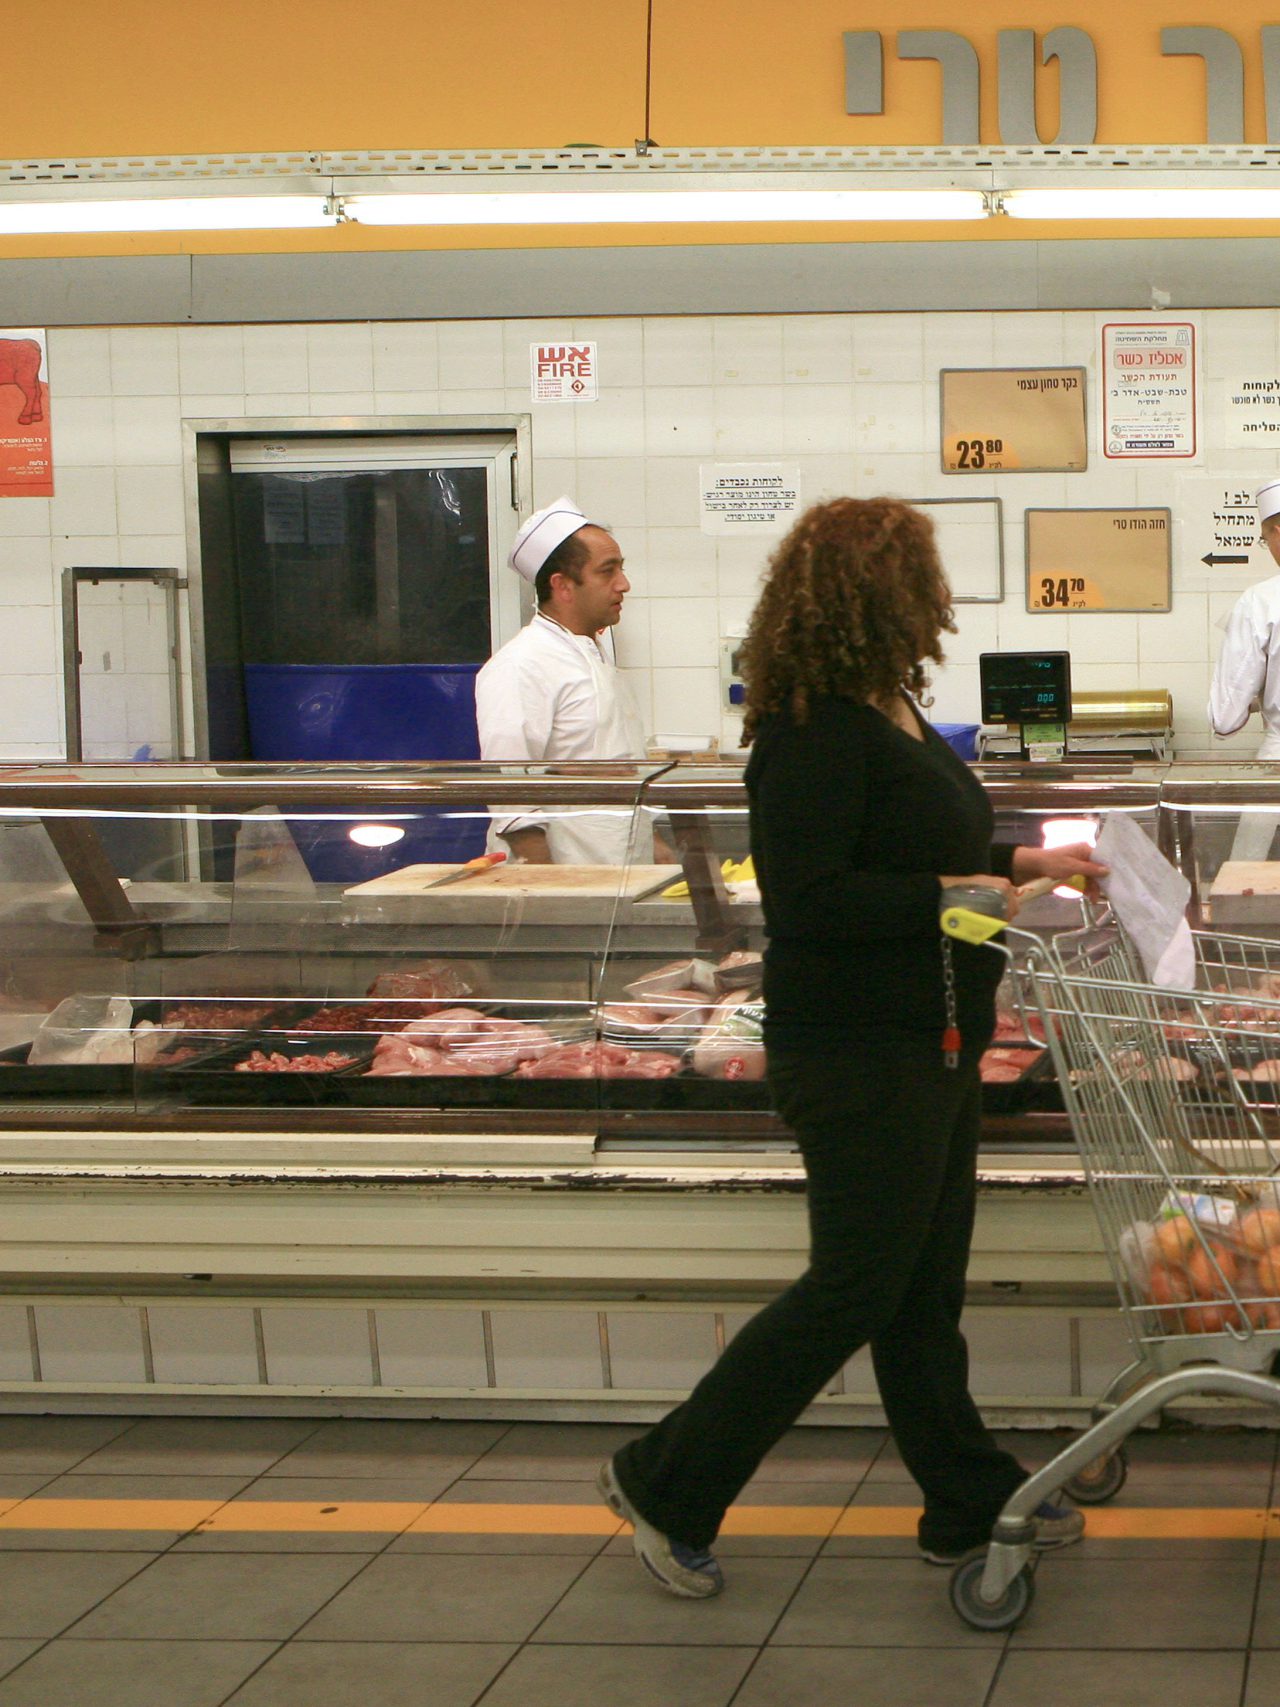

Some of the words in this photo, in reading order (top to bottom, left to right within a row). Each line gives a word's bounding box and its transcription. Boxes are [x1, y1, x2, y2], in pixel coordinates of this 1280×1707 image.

[843, 26, 1097, 145] טרי
[538, 346, 590, 362] אש
[1117, 353, 1143, 366] כשר
[1149, 351, 1183, 365] אטליז
[538, 362, 592, 378] FIRE
[1121, 374, 1146, 382] הכשר
[1149, 373, 1177, 381] תעודת
[1017, 379, 1039, 391] עצמי
[1040, 379, 1059, 393] טחון
[1061, 378, 1078, 391] בקר
[1252, 394, 1260, 404] לא
[956, 440, 985, 469] 23
[985, 439, 1003, 453] 80
[752, 476, 783, 486] לקוחות
[1234, 490, 1250, 505] לב
[1113, 519, 1127, 530] טרי
[1130, 519, 1147, 529] הודו
[1149, 519, 1165, 530] חזה
[1213, 512, 1255, 526] מתחיל
[1214, 533, 1254, 547] שמאל
[1041, 578, 1070, 607] 34
[1070, 578, 1085, 592] 70
